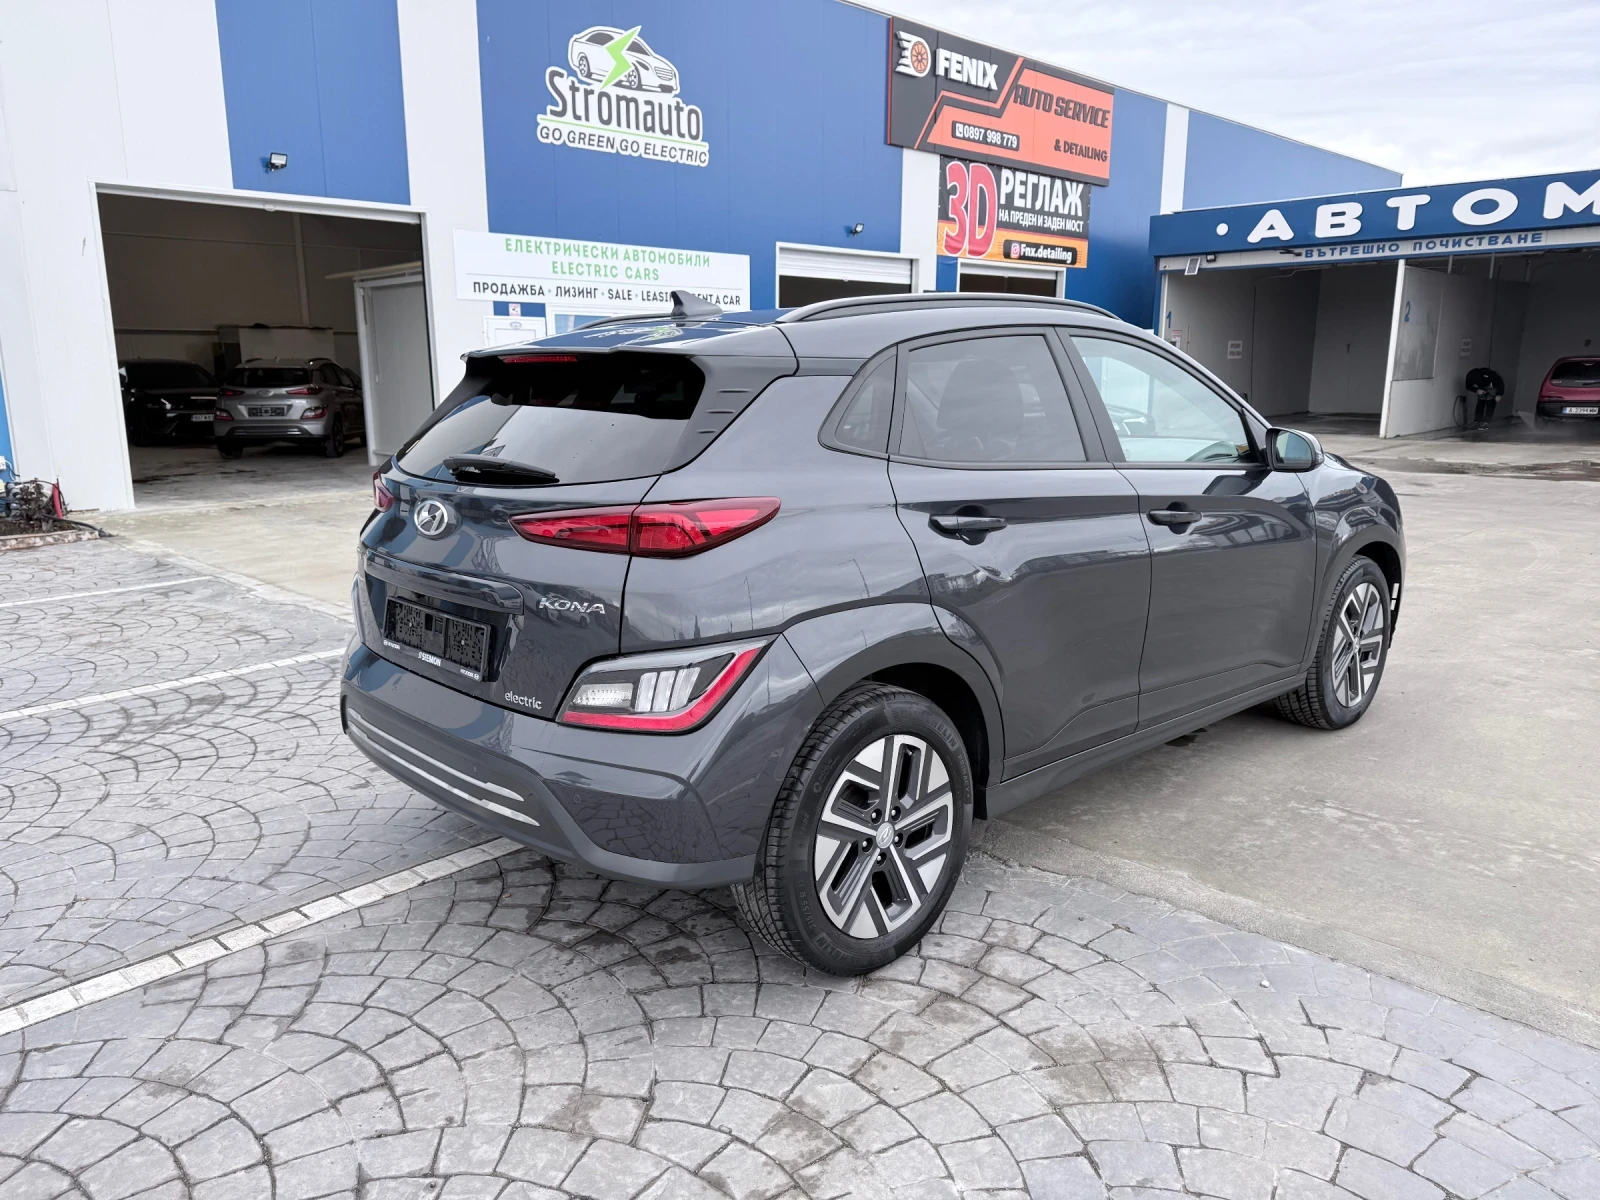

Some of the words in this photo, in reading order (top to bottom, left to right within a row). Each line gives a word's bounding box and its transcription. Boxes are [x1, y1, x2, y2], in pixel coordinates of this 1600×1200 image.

[937, 48, 998, 90] FENIX
[549, 70, 700, 140] Stromauto
[1013, 84, 1053, 112] AUTO
[1054, 97, 1110, 128] SERVICE
[540, 126, 562, 141] GO
[567, 130, 615, 149] GREEN
[619, 139, 640, 153] GO
[644, 143, 707, 163] ELECTRIC
[963, 124, 984, 141] 0897
[986, 130, 1001, 145] 998
[1002, 133, 1018, 148] 779
[1054, 139, 1062, 152] &
[1063, 141, 1108, 162] DETAILING
[1000, 168, 1084, 217] РЕГЛАЖ
[943, 161, 998, 259] 3D
[999, 209, 1009, 222] НА
[1010, 211, 1037, 227] ПРЕДЕН
[1037, 215, 1043, 226] И
[1043, 216, 1065, 231] ЗАДЕН
[1066, 219, 1084, 233] МОСТ
[1247, 181, 1600, 243] АВТОМ
[505, 238, 619, 260] ЕЛЕКТРИЧЕСКИ
[623, 248, 710, 267] АВТОМОБИЛИ
[1020, 244, 1073, 264] Fnx.detailing
[1304, 243, 1400, 259] ВЪТРЕШНО
[1413, 232, 1543, 251] ПОЧИСТВАНЕ
[552, 261, 618, 278] ELECTRIC
[625, 266, 660, 281] CARS
[473, 282, 545, 296] ПРОДАЖБА
[555, 286, 598, 299] ЛИЗИНГ
[608, 288, 633, 301] SALE
[641, 290, 674, 303] LEASI
[715, 295, 721, 305] A
[722, 295, 741, 306] CAR
[1166, 311, 1172, 328] 1
[1404, 300, 1411, 322] 2
[538, 597, 606, 614] KONA
[505, 690, 542, 710] electric
[958, 754, 970, 791] PRIMACY
